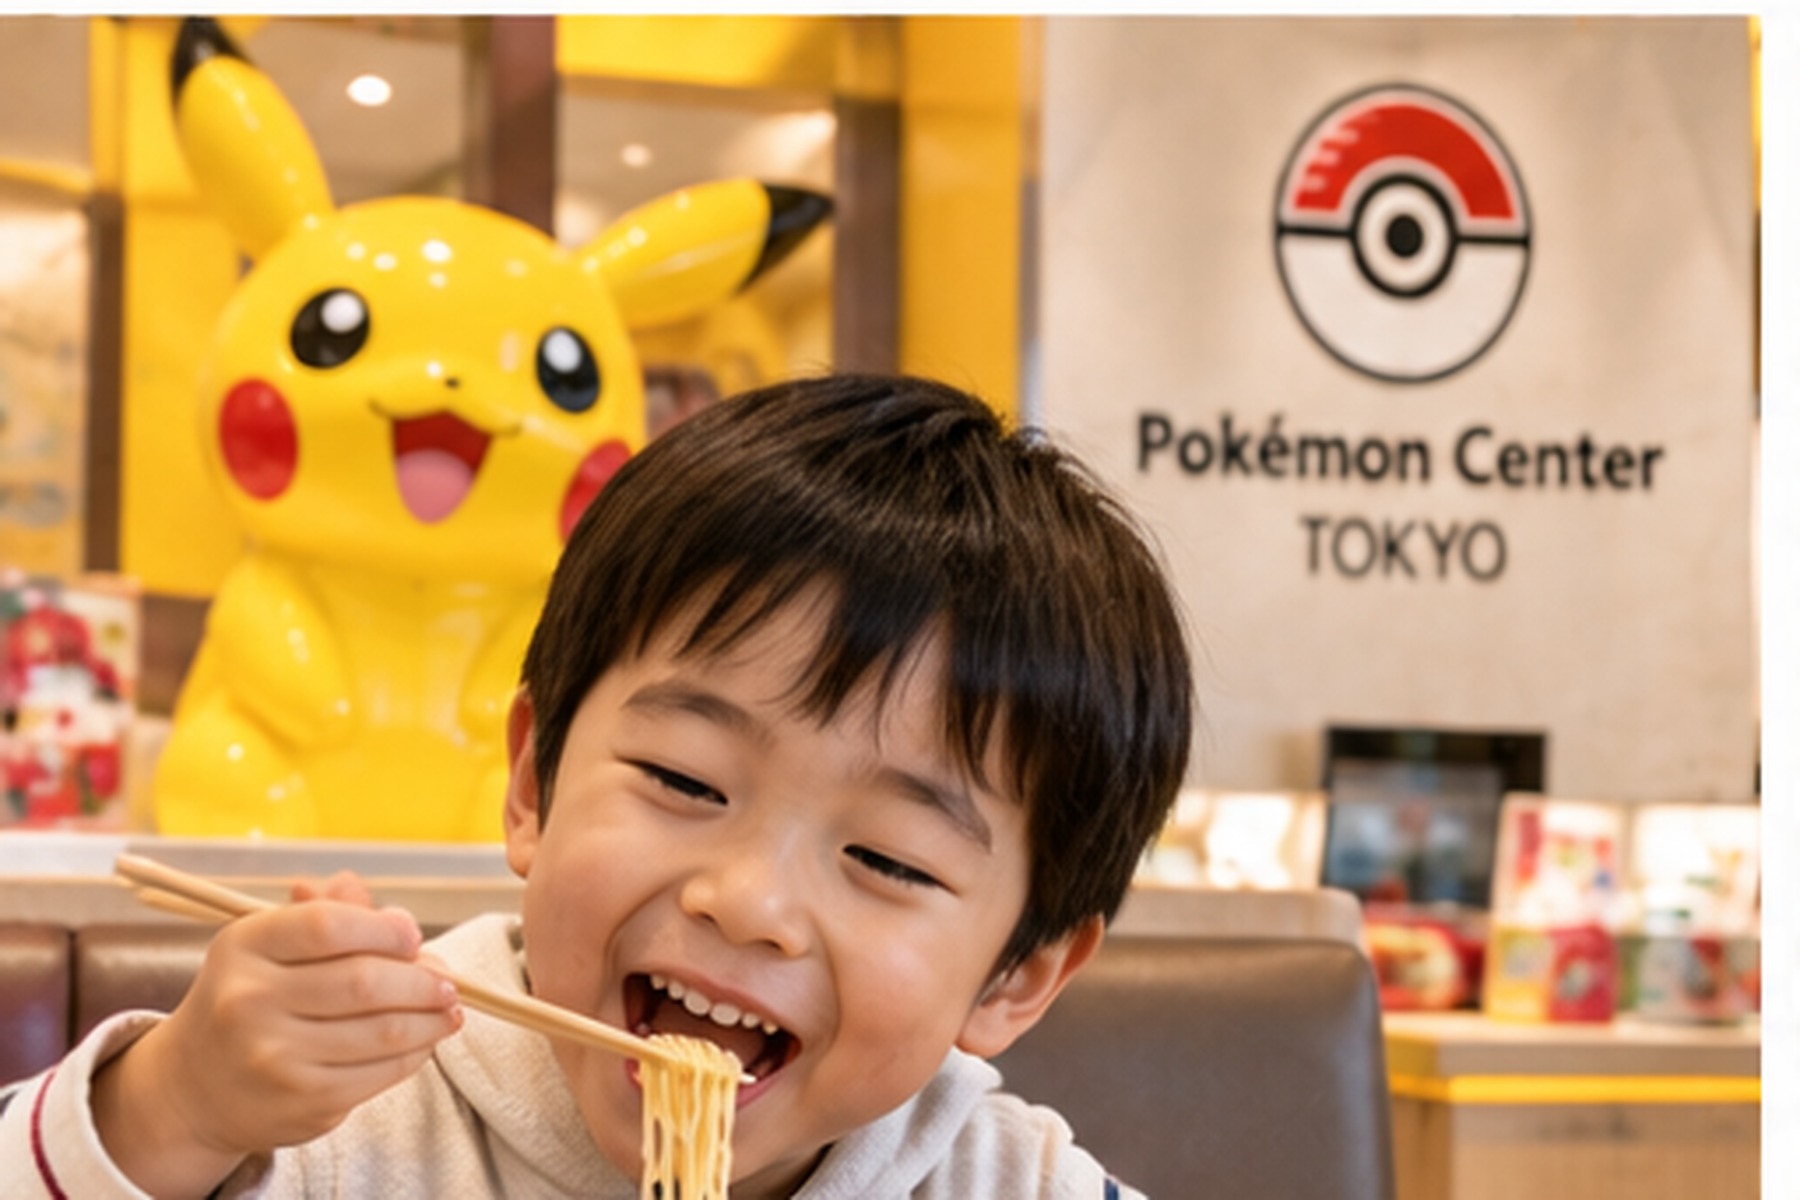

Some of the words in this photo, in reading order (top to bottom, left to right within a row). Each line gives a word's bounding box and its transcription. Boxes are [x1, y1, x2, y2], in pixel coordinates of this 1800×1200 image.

[1137, 411, 1432, 483] Pokémon
[1453, 425, 1664, 491] Center
[1300, 515, 1508, 583] TOKYO
